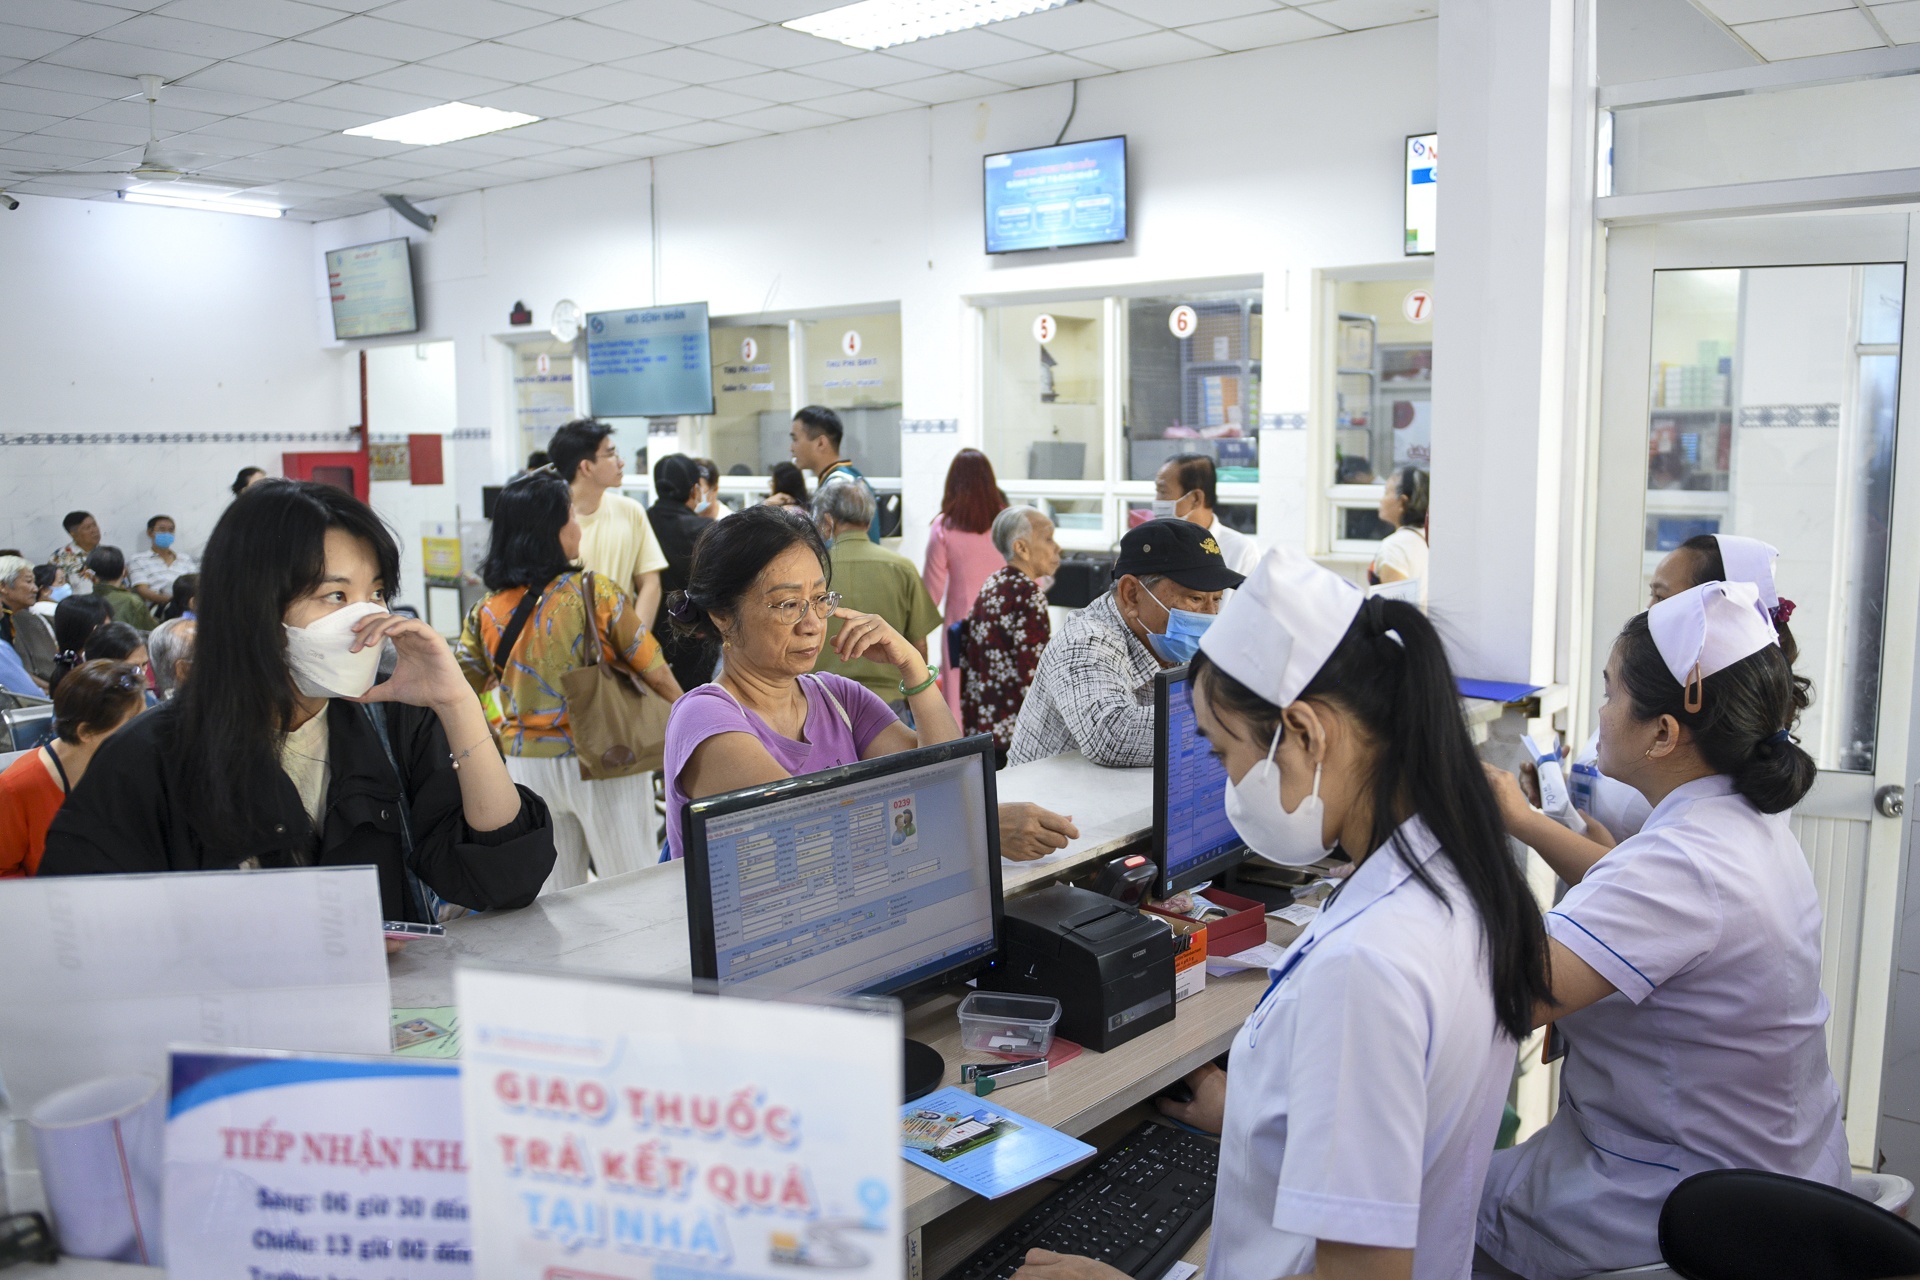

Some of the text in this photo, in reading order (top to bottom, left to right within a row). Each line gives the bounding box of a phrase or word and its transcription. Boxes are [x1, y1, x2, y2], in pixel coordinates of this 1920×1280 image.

[1413, 296, 1425, 318] 7
[1041, 318, 1048, 339] 5
[1177, 311, 1188, 331] 6
[746, 341, 752, 359] 3
[849, 334, 856, 352] 4
[540, 356, 547, 372] 1
[893, 798, 911, 809] 0239
[495, 1070, 796, 1146] GIAO THUỐC
[220, 1116, 471, 1174] TIẾP NHẬN KH
[498, 1130, 812, 1210] TRẢ KẾT QUẢ
[355, 1195, 390, 1220] giờ
[521, 1190, 724, 1258] TẠI NHÀ
[324, 1233, 352, 1257] 13
